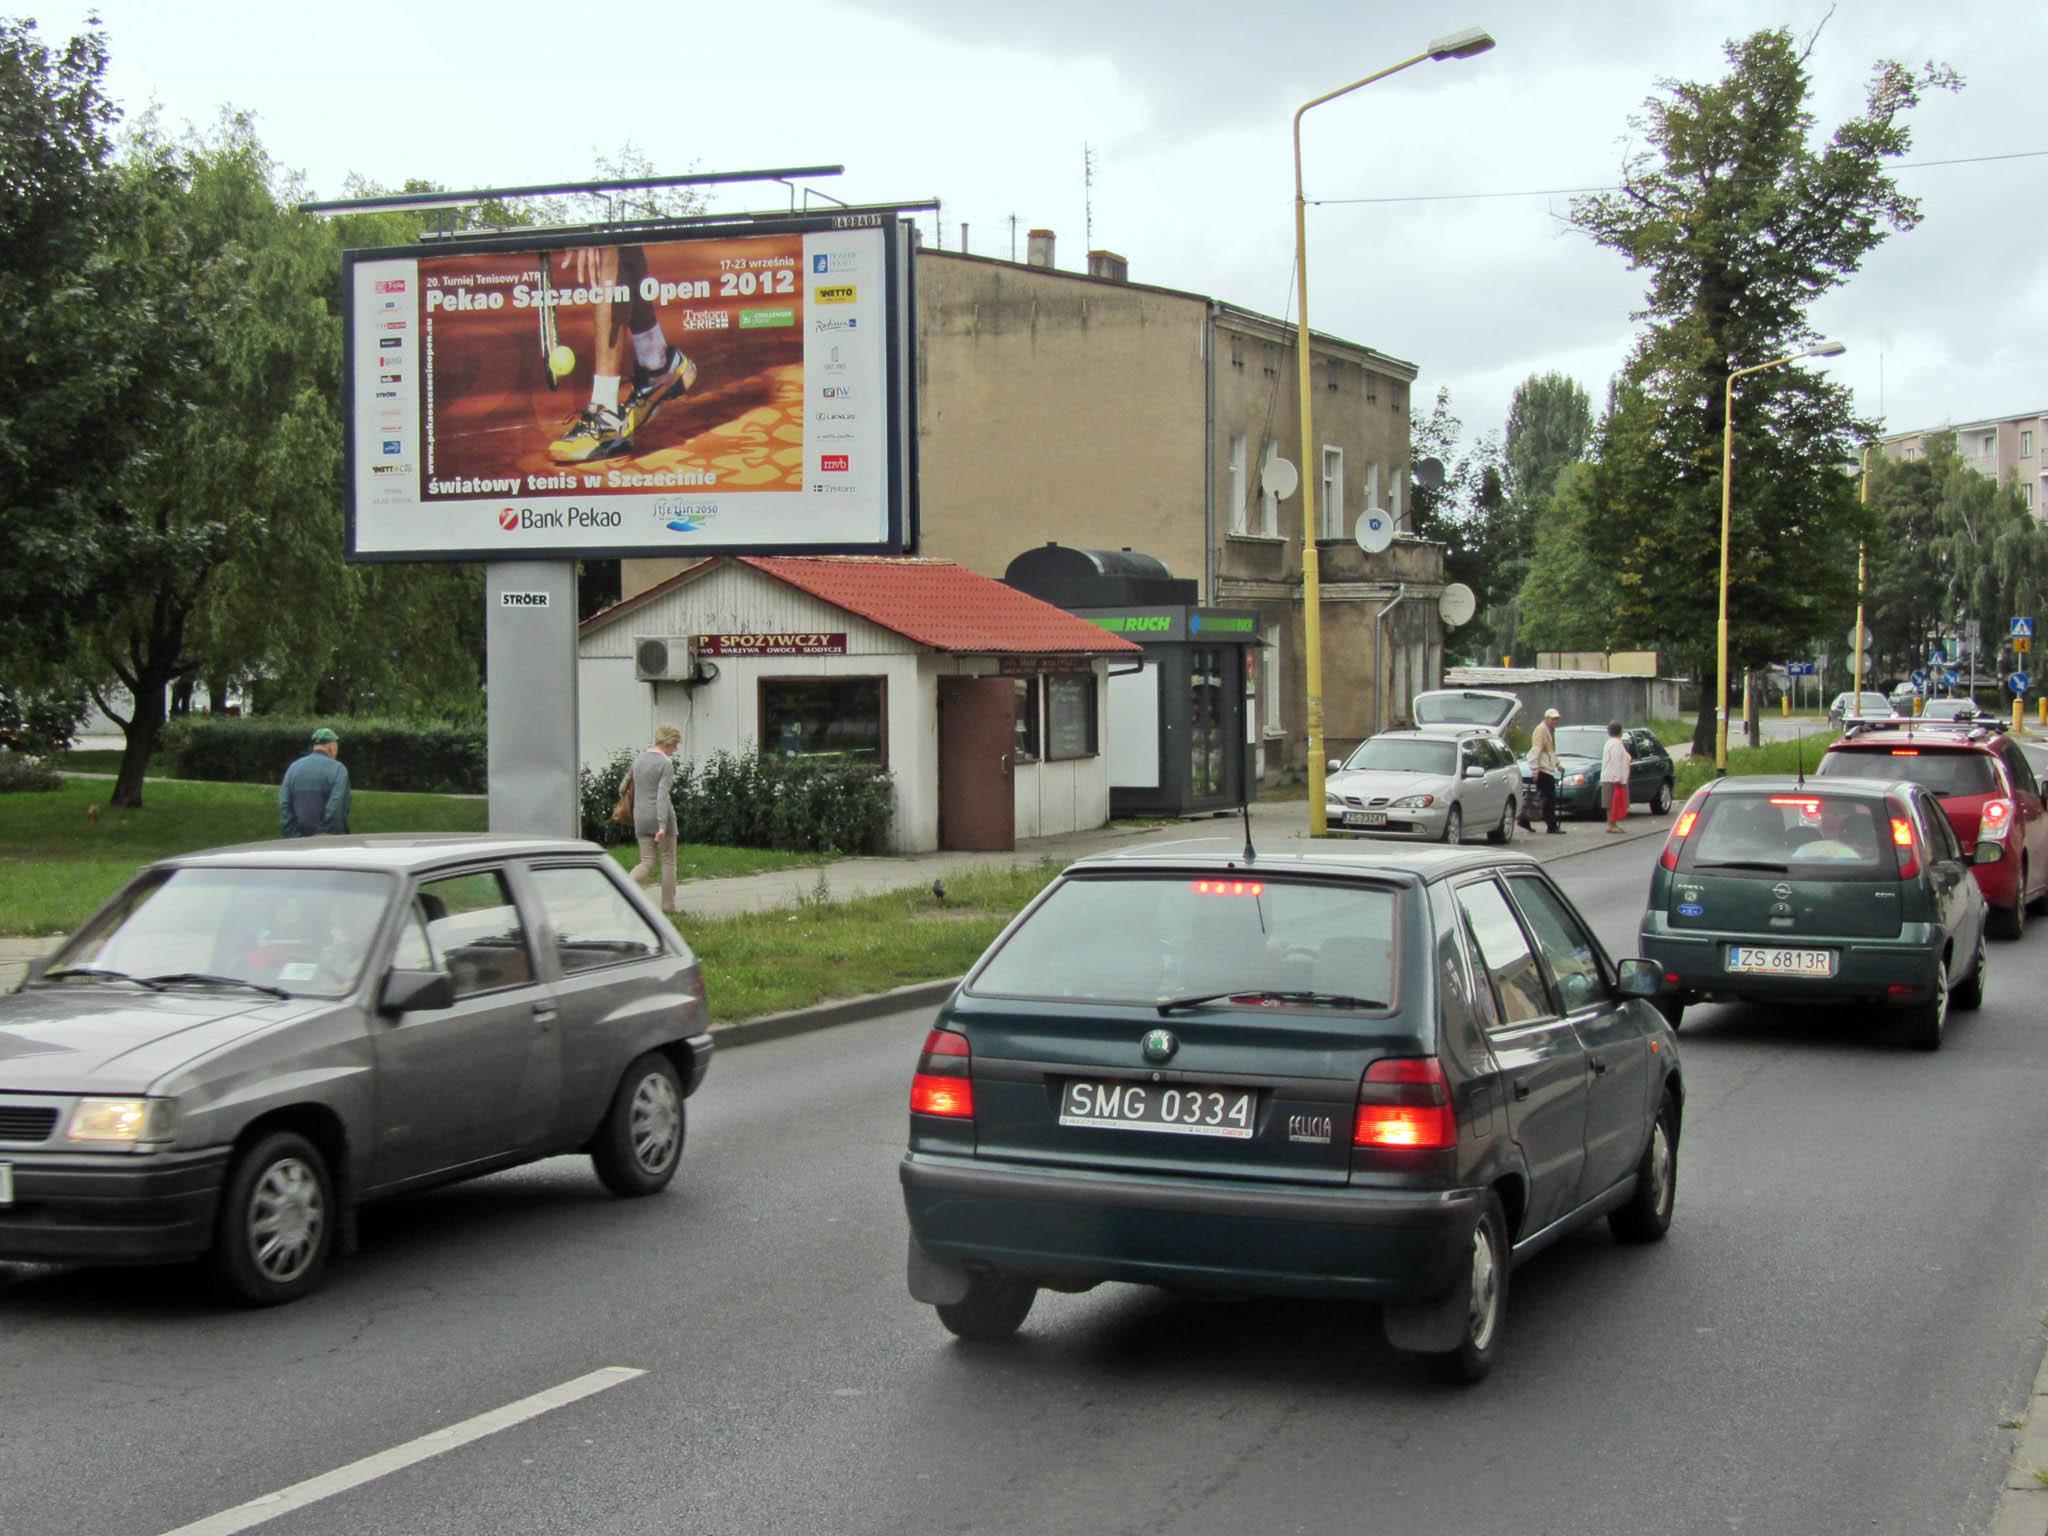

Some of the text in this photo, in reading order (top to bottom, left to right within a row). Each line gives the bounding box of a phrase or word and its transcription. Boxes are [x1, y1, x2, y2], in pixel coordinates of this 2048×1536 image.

[721, 256, 795, 270] 17-23 września
[426, 271, 541, 287] 20. Turniej Tenisowy ATP
[426, 287, 504, 312] Pekao
[512, 280, 630, 308] Szczecin
[639, 277, 710, 306] Open
[720, 270, 795, 297] 2012
[683, 309, 729, 321] Tretorn
[683, 319, 717, 330] SERIE
[823, 457, 847, 469] mvb
[428, 469, 717, 495] światowy tenis w Szczecinie
[696, 504, 719, 515] 2050
[521, 507, 622, 529] Bank Pekao
[503, 593, 548, 606] STRÖER
[1125, 616, 1171, 632] RUCH
[720, 633, 831, 647] SPOŻYWCZY
[1741, 949, 1828, 970] ZS 6813R
[1070, 1083, 1250, 1128] SMG 0334
[1288, 1113, 1332, 1138] FELICIA
